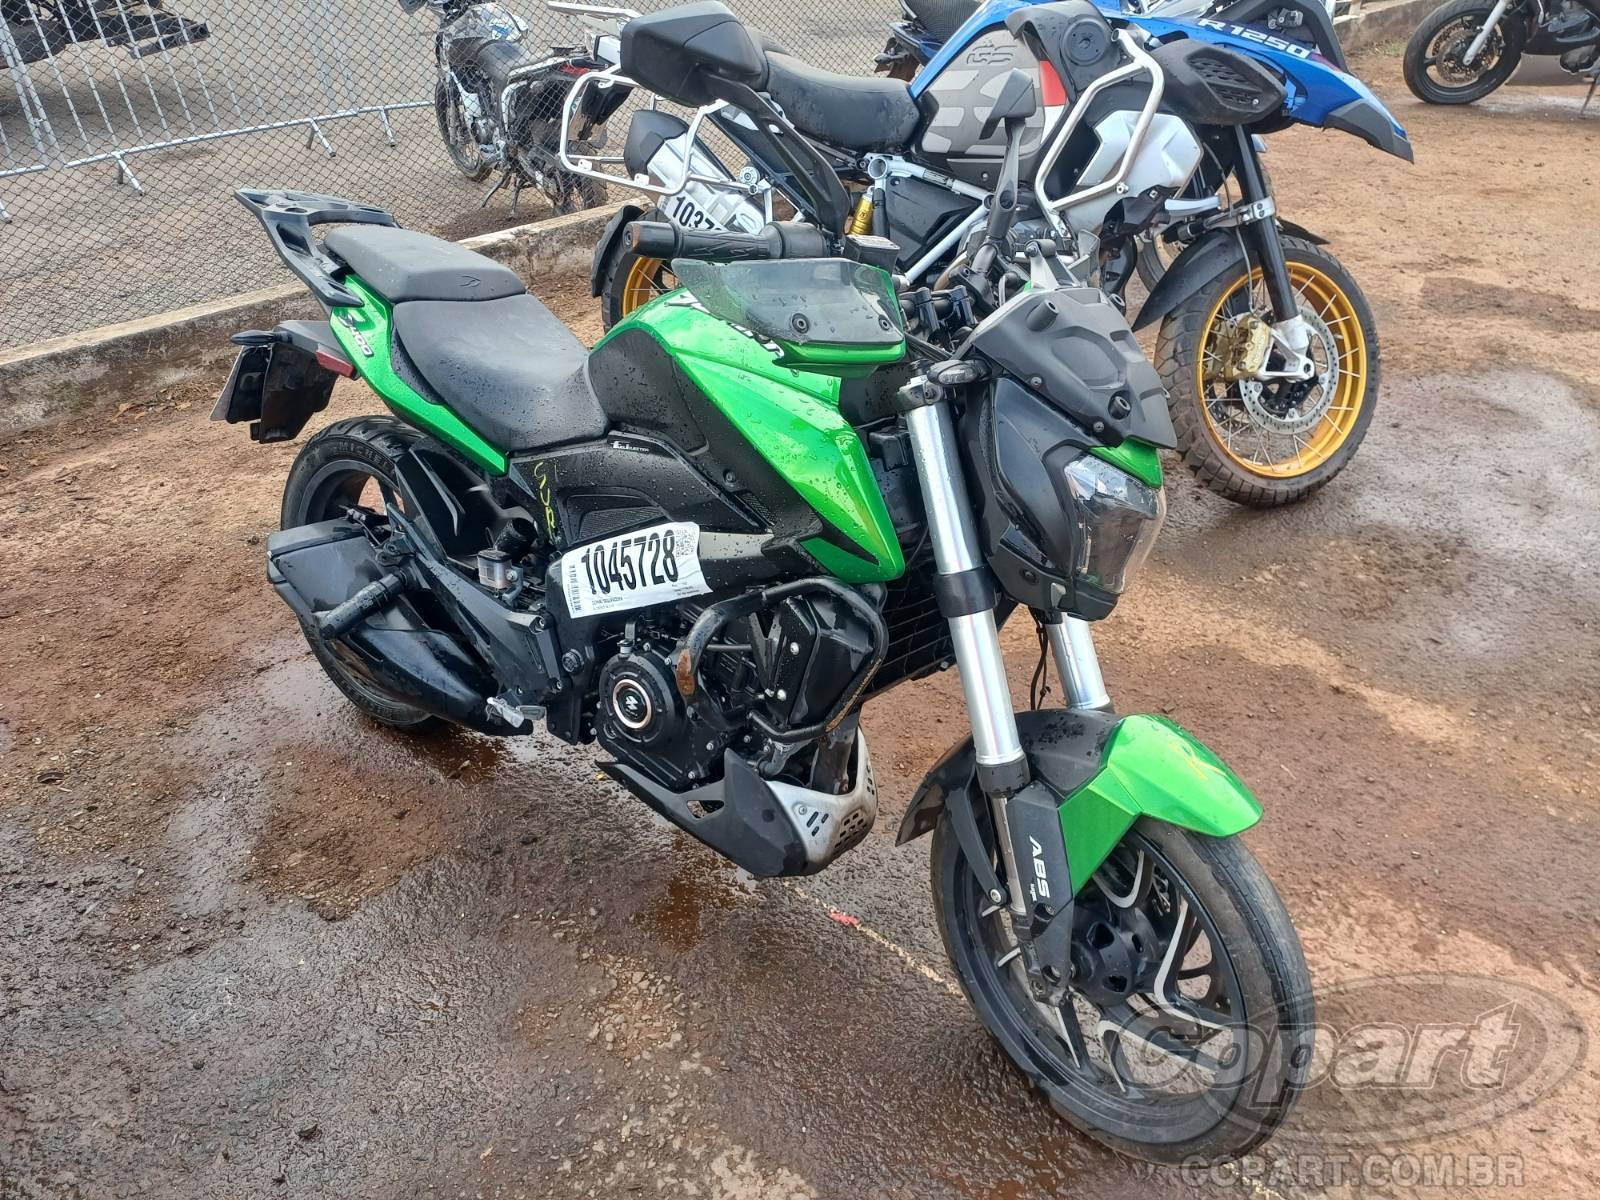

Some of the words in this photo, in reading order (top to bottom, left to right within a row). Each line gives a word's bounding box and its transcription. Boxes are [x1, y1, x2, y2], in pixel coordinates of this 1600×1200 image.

[1197, 17, 1227, 32] R
[1229, 24, 1312, 60] 1250
[672, 196, 722, 231] 1037
[580, 529, 679, 595] 1045728
[1028, 834, 1051, 899] ABS
